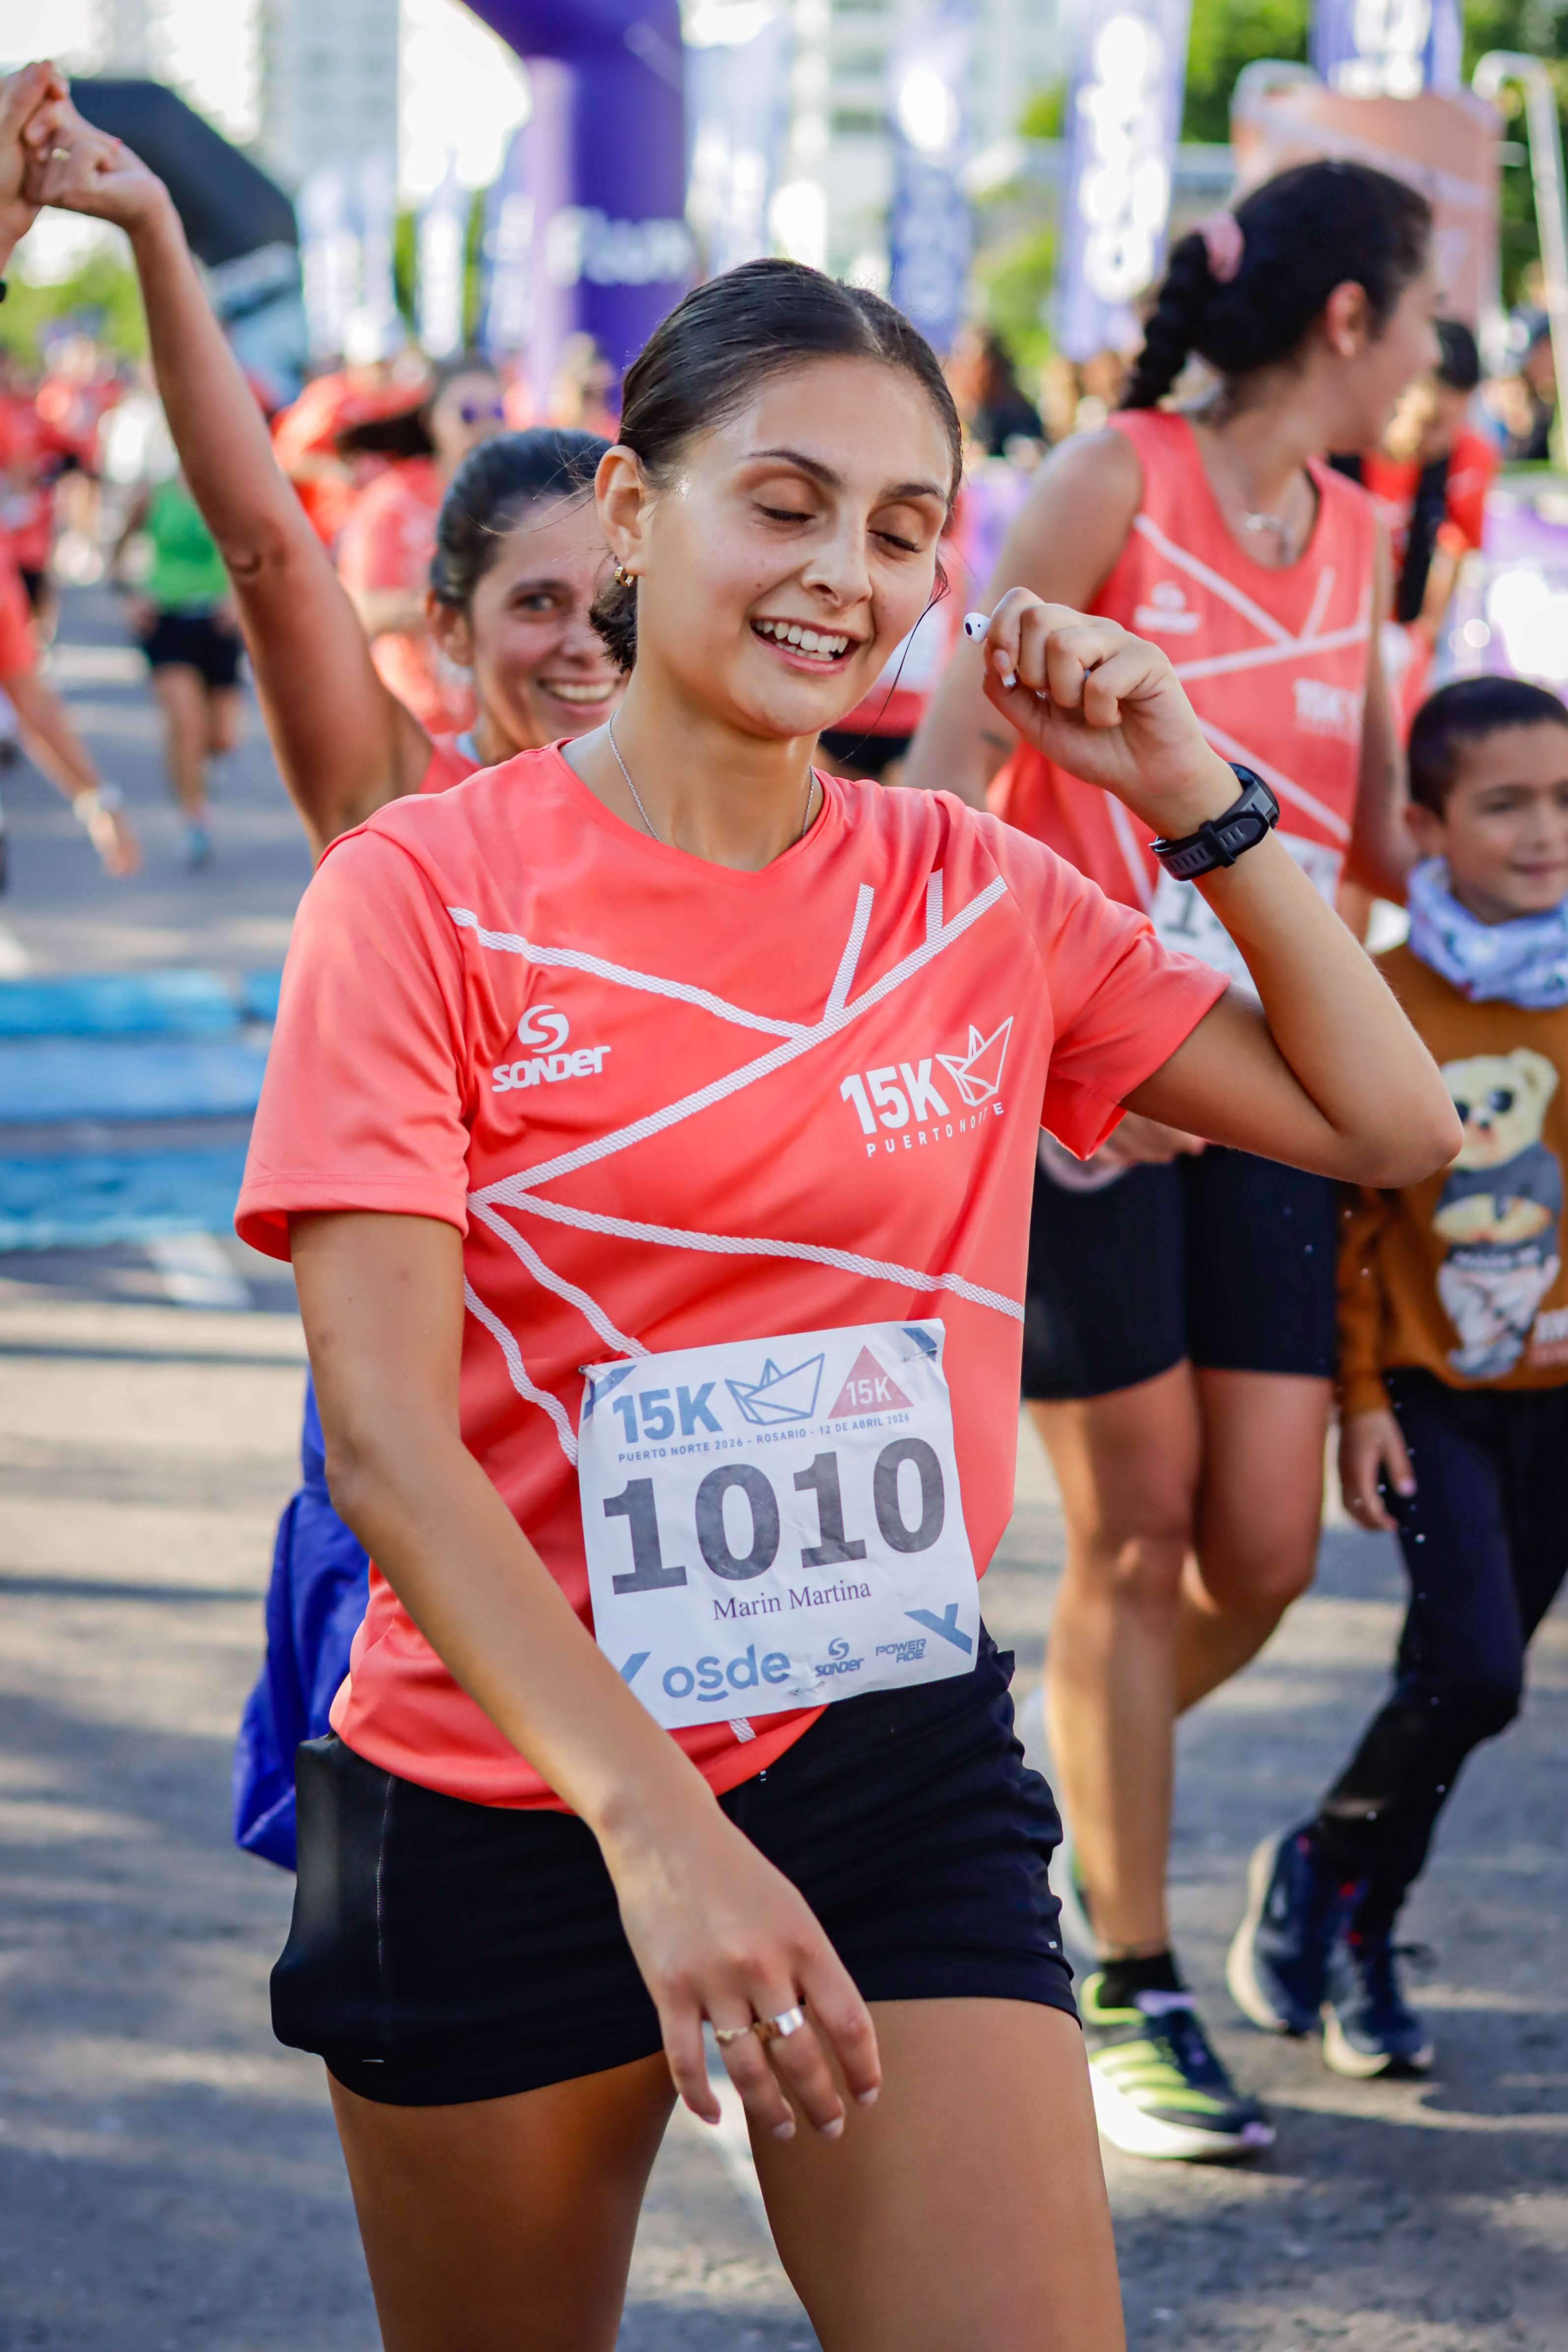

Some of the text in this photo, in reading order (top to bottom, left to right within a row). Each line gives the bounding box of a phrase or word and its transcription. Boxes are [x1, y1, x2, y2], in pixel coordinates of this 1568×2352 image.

[839, 1058, 950, 1135] 15K
[612, 1381, 723, 1444] 15K
[846, 1376, 893, 1407] 15K
[618, 1448, 667, 1463] PUERTO
[671, 1441, 710, 1456] NORTE
[714, 1437, 743, 1450] 2026
[756, 1428, 806, 1444] ROSARIO
[820, 1425, 831, 1435] 12
[836, 1421, 848, 1433] DE
[852, 1417, 884, 1430] ABRIL
[887, 1412, 910, 1425] 2026
[603, 1437, 945, 1595] 1010
[712, 1579, 872, 1620] Marin Martina
[662, 1643, 792, 1699] osde
[876, 1638, 926, 1657] POWER
